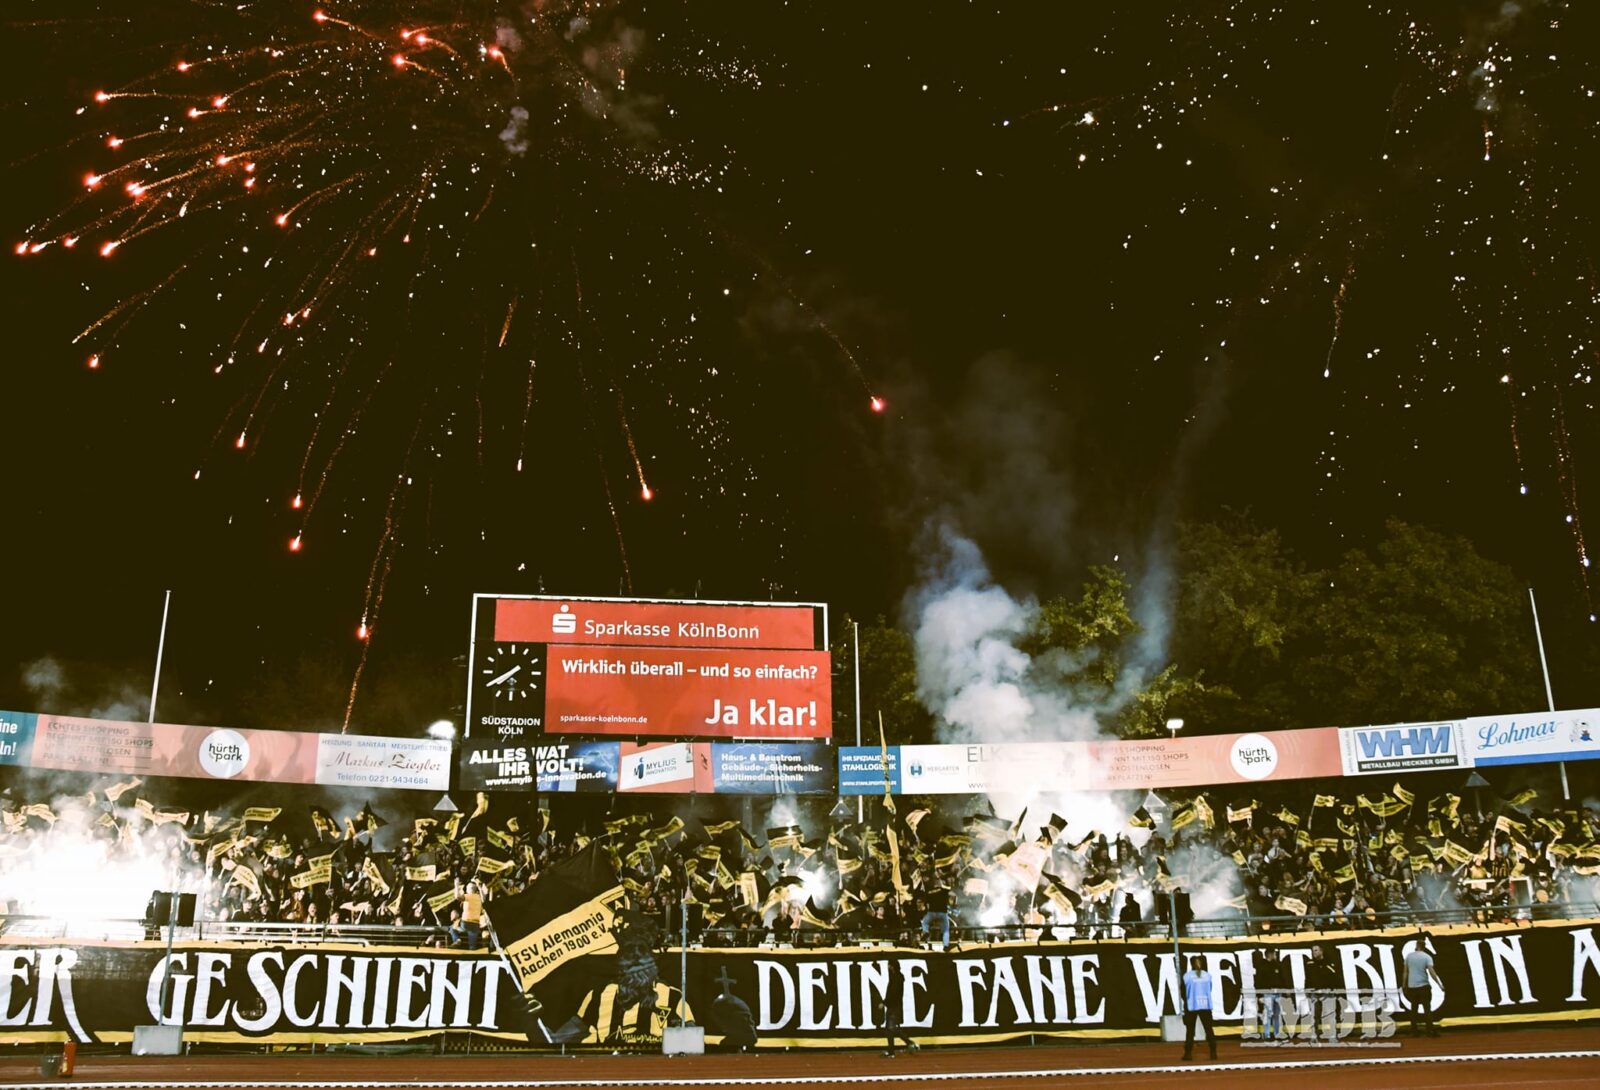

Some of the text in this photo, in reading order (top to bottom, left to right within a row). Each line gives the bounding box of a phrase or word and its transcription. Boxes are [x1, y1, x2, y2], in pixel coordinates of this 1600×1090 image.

[584, 620, 760, 641] Sparkasse KölnBonn
[562, 659, 626, 675] Wirklich
[630, 660, 683, 676] überall
[700, 663, 729, 678] und
[733, 667, 751, 678] so
[755, 663, 818, 680] einfach?
[560, 713, 648, 725] sparkasse-koelnbonn.de
[705, 699, 817, 727] Ja klar!
[481, 716, 541, 727] SÜDSTADION
[83, 724, 130, 737] SHOPPING
[498, 725, 524, 735] KÖLN
[1477, 720, 1557, 750] Lohmar
[124, 738, 155, 747] SHOPS
[209, 743, 240, 754] hürth
[321, 739, 352, 747] HEIZUNG
[1357, 727, 1451, 758] WHM
[215, 752, 243, 762] park
[469, 745, 570, 764] ALLES WAT
[721, 753, 802, 763] Haus- & Baustrom
[1162, 753, 1190, 761] SHOPS
[1238, 747, 1267, 757] hürth
[645, 757, 677, 770] MYLIUS
[1246, 755, 1272, 765] park
[1361, 757, 1455, 770] METALLBAU HECKNER GMBH
[498, 758, 585, 776] IHR VOLT!
[769, 763, 823, 773] Sicherheits-
[337, 773, 429, 785] Telefon 0221-9434684
[721, 773, 804, 783] Multimediatechnik
[511, 911, 605, 966] TSV Alemannia
[520, 949, 564, 979] Aachen
[563, 934, 591, 951] 1900
[753, 959, 935, 1031] DEINE
[1335, 936, 1446, 1015] BIS
[1460, 934, 1539, 1009] IN
